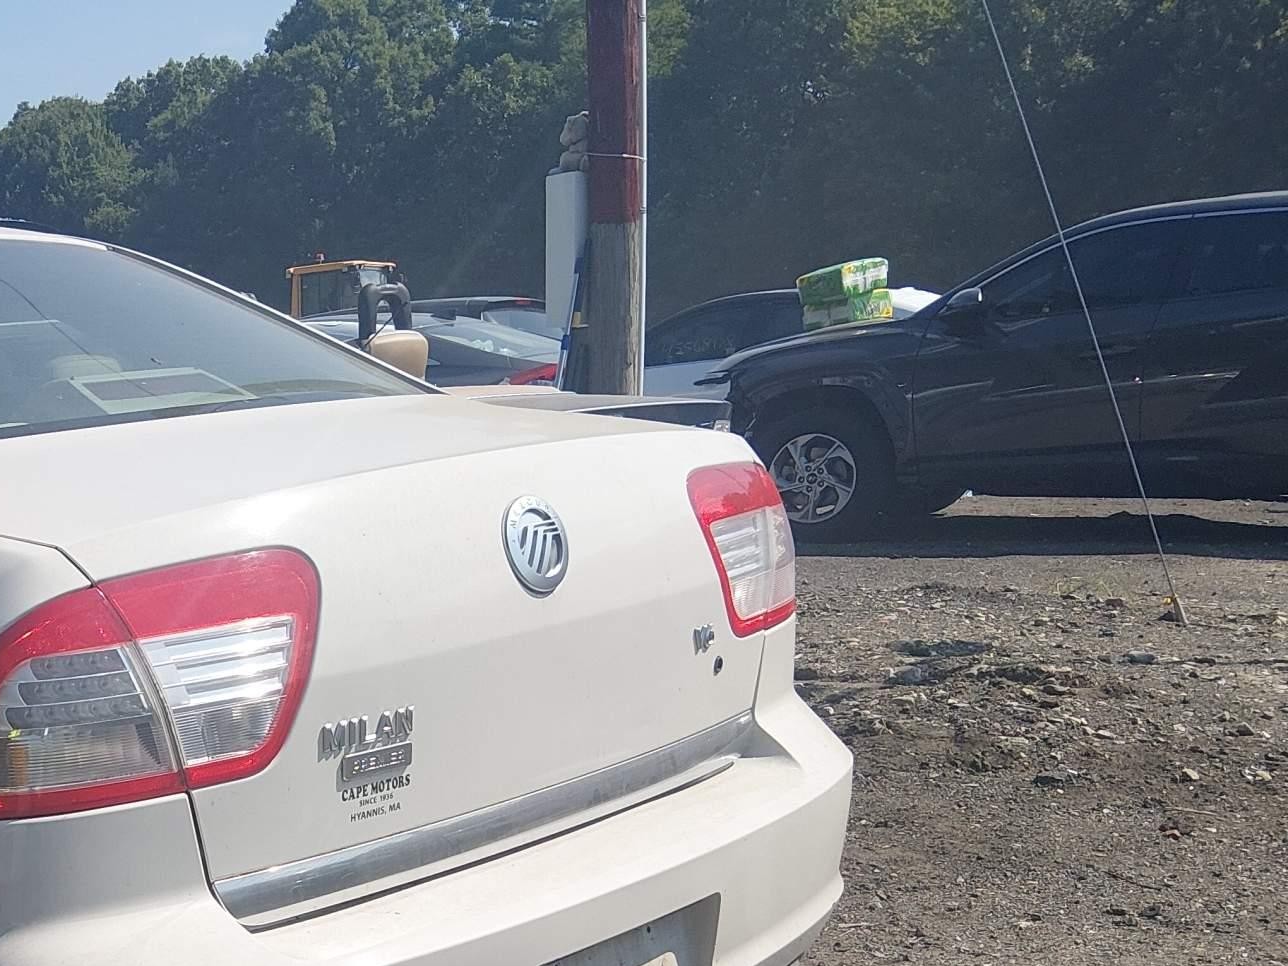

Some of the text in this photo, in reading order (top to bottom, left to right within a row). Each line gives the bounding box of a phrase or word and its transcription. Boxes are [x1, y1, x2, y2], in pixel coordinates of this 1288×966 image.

[319, 705, 414, 758] MILAN
[341, 774, 411, 802] CAPE MOTORS
[350, 802, 401, 823] HYANNIS, MA
[359, 796, 377, 808] SINCE
